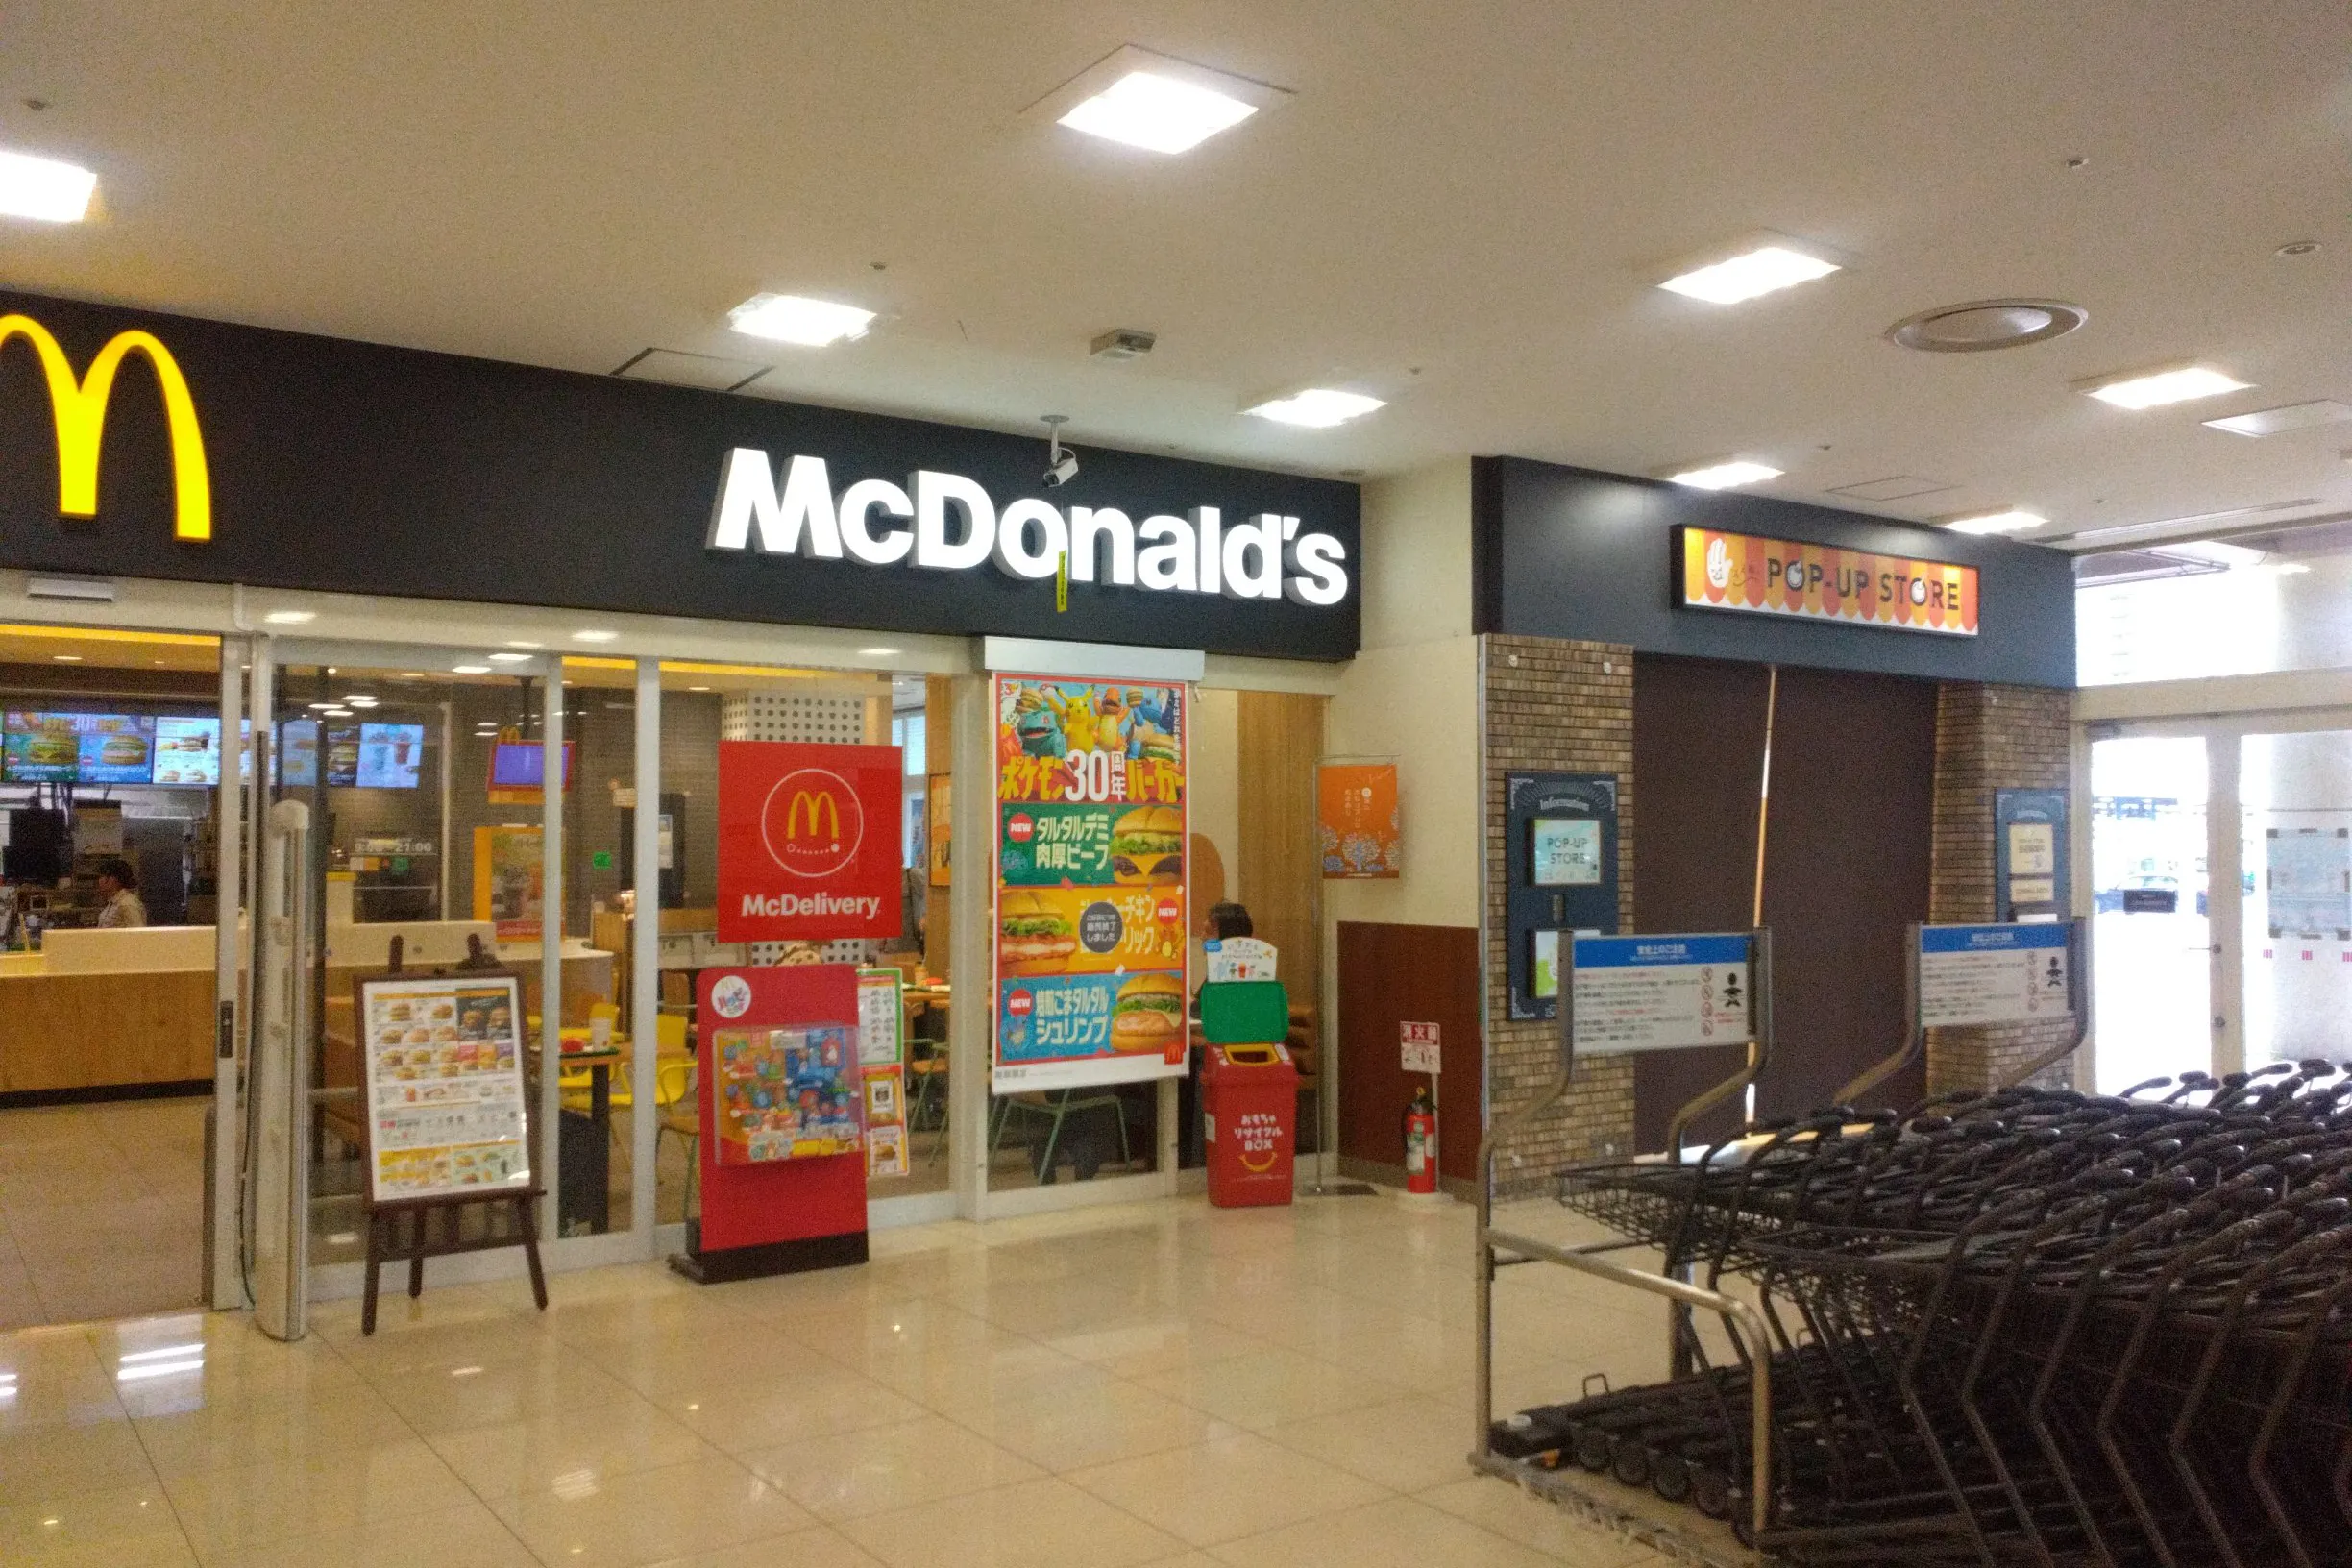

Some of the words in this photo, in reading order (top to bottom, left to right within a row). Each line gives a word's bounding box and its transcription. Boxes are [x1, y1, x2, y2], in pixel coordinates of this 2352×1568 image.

[713, 447, 1348, 605] McDonald's
[1767, 555, 1870, 599] POP-UP
[1878, 572, 1960, 611] STORE
[1010, 822, 1032, 833] NEW
[1037, 812, 1109, 842] タルタルデミ
[1036, 842, 1109, 870] 肉厚ビーフ
[741, 893, 880, 919] McDelivery
[1158, 907, 1178, 917] NEW
[1009, 998, 1032, 1009] NEW
[1036, 1016, 1109, 1045] シュリンプ
[1234, 1127, 1284, 1139] リサイクル
[1244, 1139, 1273, 1151] BOX
